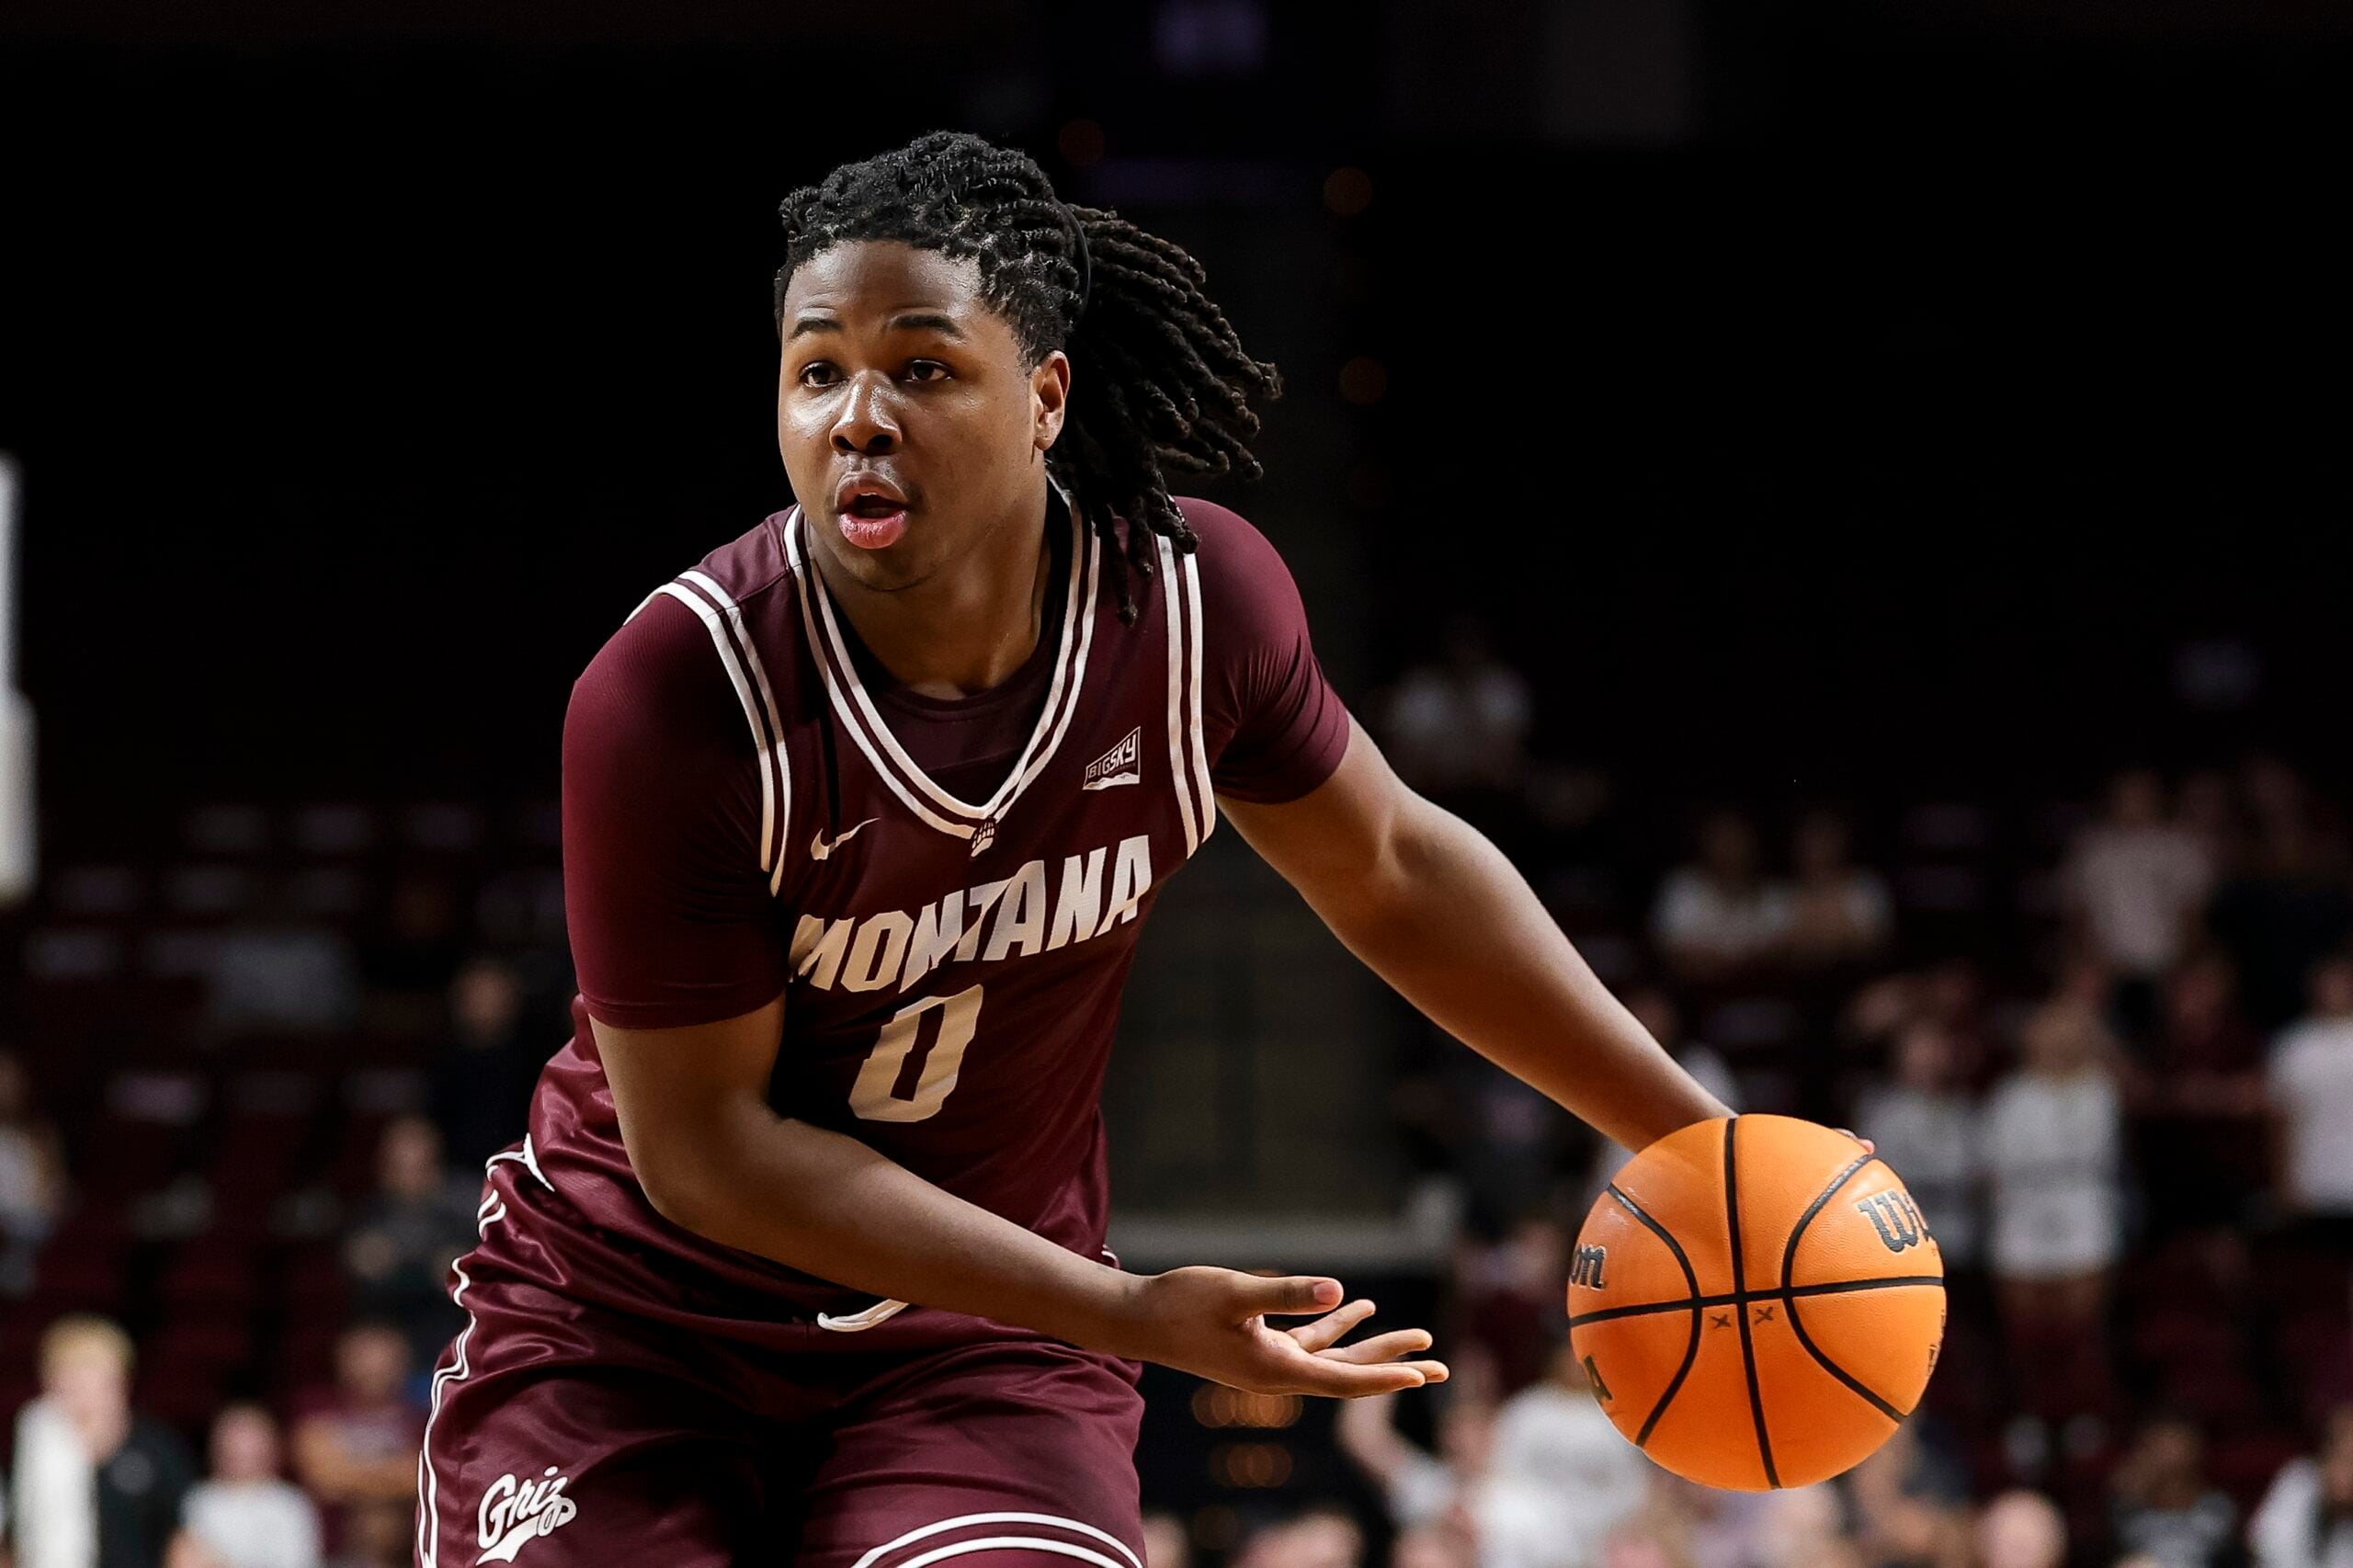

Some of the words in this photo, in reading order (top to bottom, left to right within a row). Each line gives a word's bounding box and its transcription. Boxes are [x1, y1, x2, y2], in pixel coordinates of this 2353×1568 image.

[789, 835, 1153, 994] MONTANA
[848, 984, 983, 1123] 0
[477, 1465, 577, 1565] Griz
